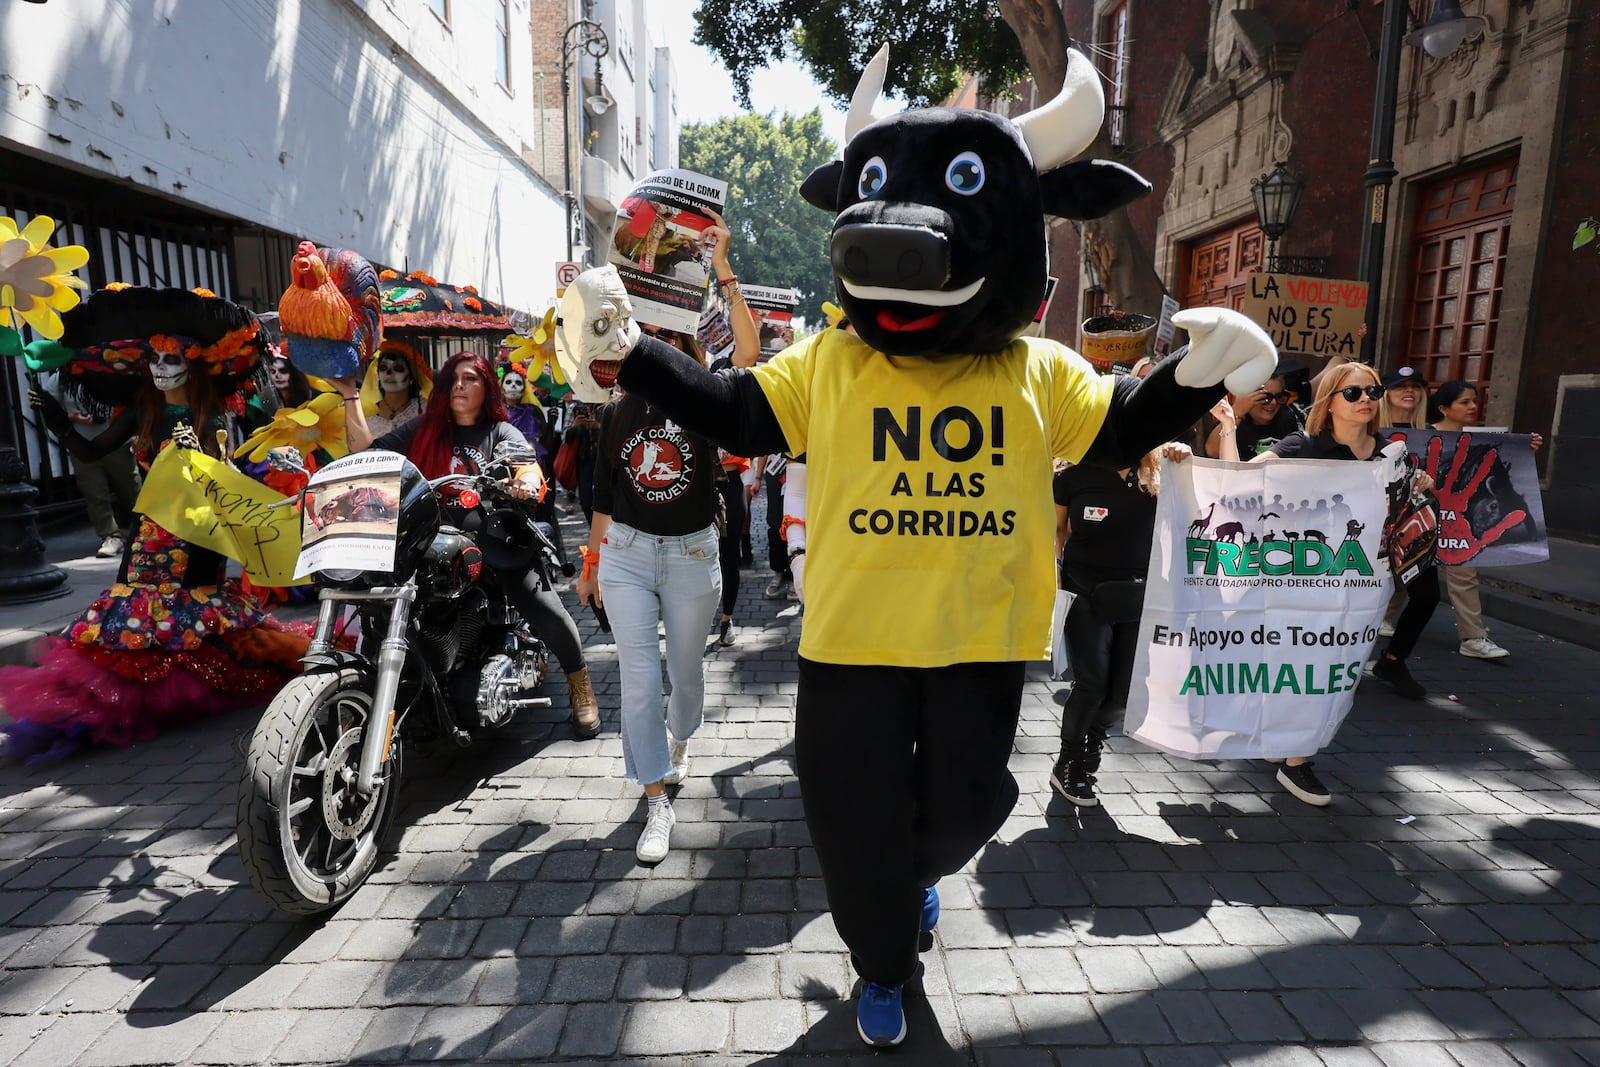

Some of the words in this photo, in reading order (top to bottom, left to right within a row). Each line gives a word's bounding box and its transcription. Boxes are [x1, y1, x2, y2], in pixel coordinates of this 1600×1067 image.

[646, 188, 691, 206] CORRUPCIÓN
[673, 177, 684, 189] DE
[685, 180, 695, 192] LA
[696, 184, 721, 200] CDMX
[618, 269, 637, 280] VOTAR
[637, 275, 660, 287] TAMBIÉN
[668, 283, 702, 297] CORRUPCIÓN
[1252, 275, 1280, 300] LA
[1287, 278, 1367, 309] VIOLENCIA
[1267, 305, 1297, 328] NO
[1307, 307, 1333, 330] ES
[1264, 329, 1355, 354] ULTURA
[620, 431, 646, 461] FUCK
[648, 428, 693, 461] CORRIDA
[873, 406, 1004, 466] NO!
[646, 464, 693, 502] CRUELTY
[890, 472, 912, 496] A
[926, 472, 985, 498] LAS
[849, 509, 1016, 536] CORRIDAS
[1186, 537, 1374, 576] FRECDA
[1184, 577, 1204, 586] FRENTE
[1205, 577, 1260, 588] CIUDADANO
[1261, 578, 1341, 588] PRO-DERECHO
[1343, 578, 1383, 588] ANIMAL
[1152, 624, 1183, 647] En
[1189, 626, 1244, 651] Apoyo
[1250, 624, 1281, 645] de
[1287, 626, 1359, 647] Todos
[1179, 661, 1361, 696] ANIMALES
